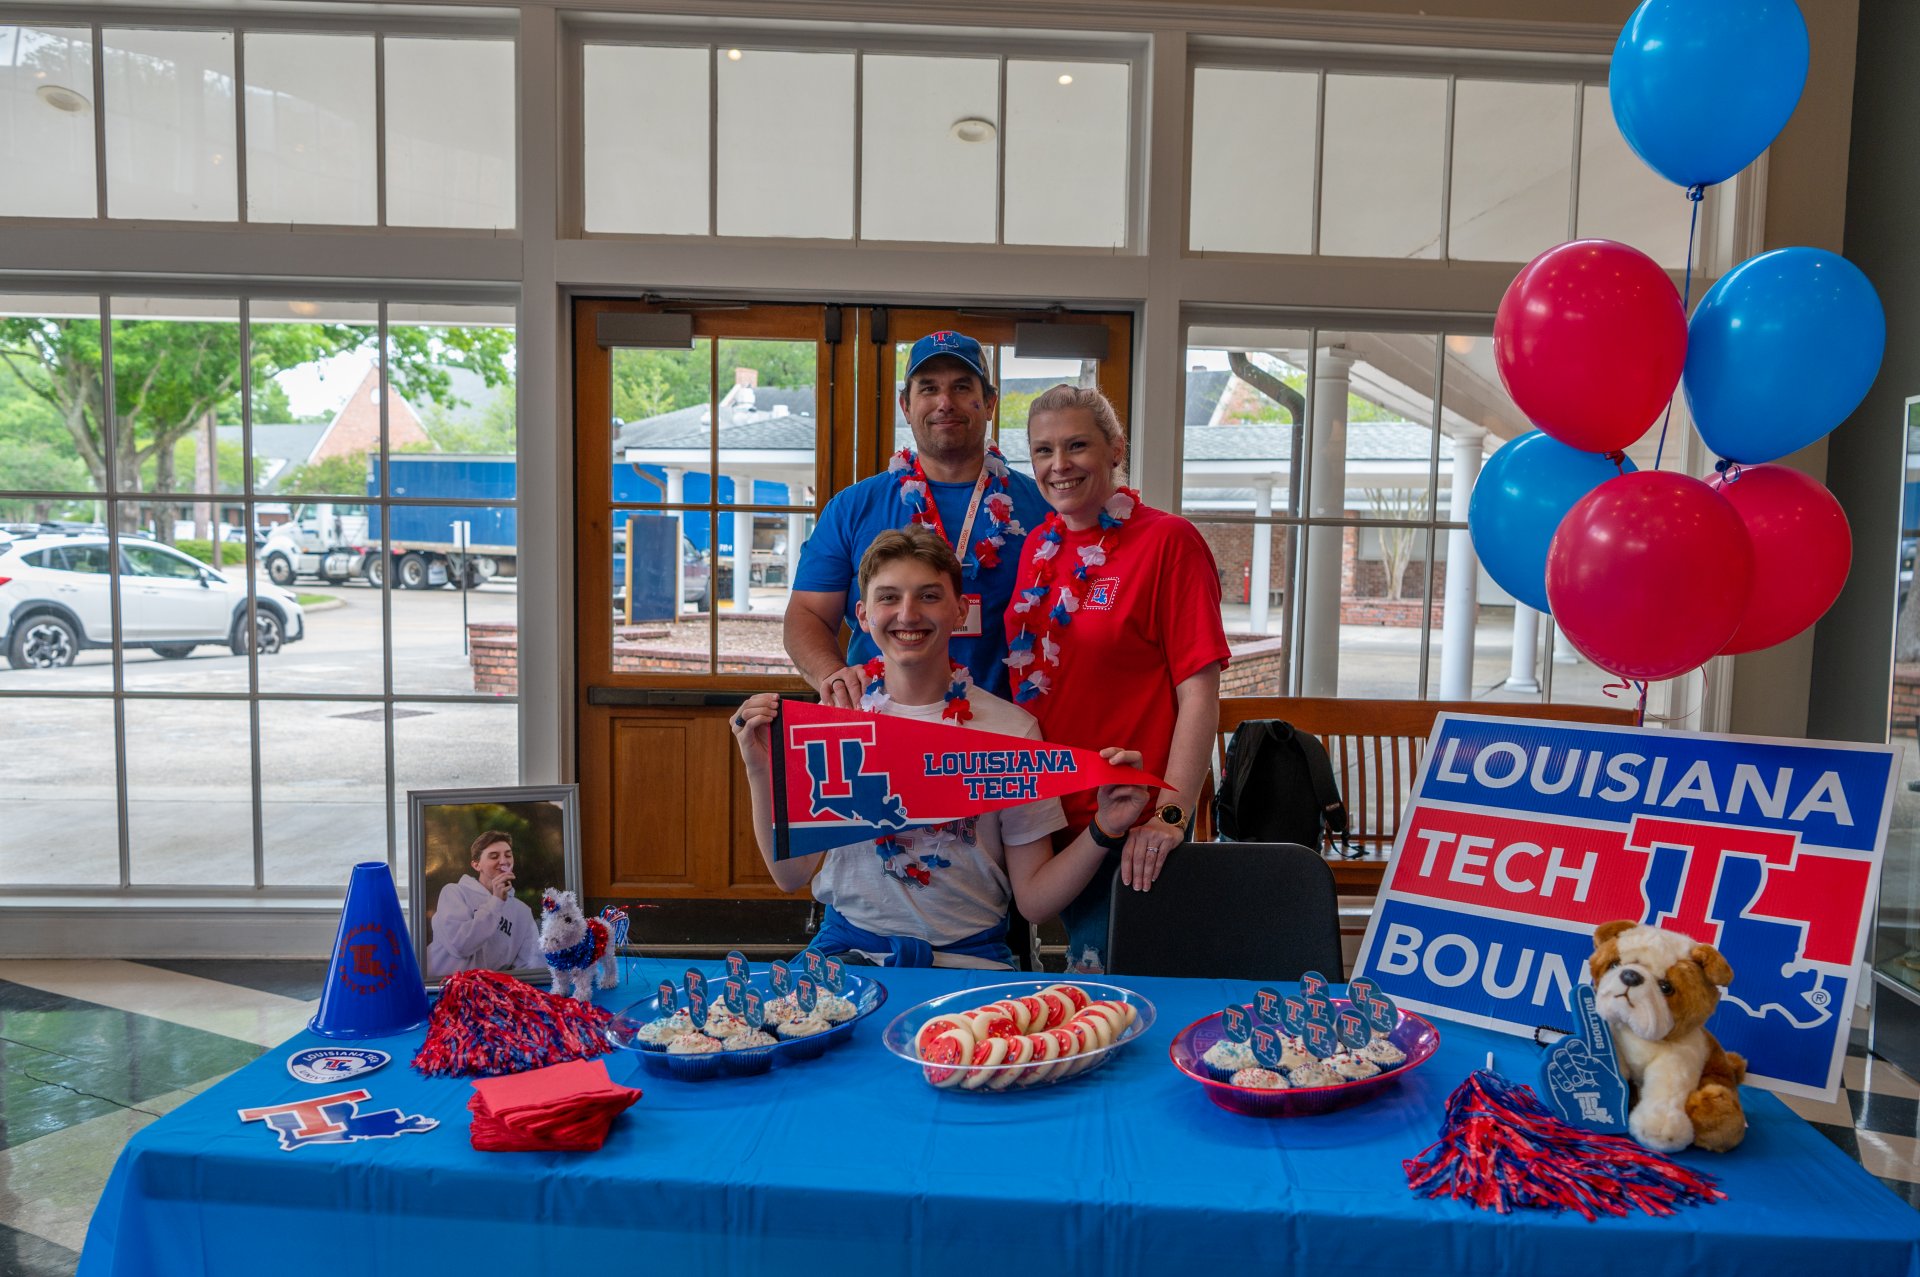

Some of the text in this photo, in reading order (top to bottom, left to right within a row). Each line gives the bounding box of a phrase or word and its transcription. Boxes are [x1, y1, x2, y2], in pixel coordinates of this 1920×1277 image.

[968, 500, 978, 519] VISITOR
[960, 529, 969, 550] VISITOR
[924, 750, 1077, 776] LOUISIANA
[963, 775, 1038, 800] TECH
[1436, 737, 1855, 827] LOUISIANA
[1416, 828, 1599, 903] TECH
[1376, 922, 1594, 1013] BOUN
[1584, 996, 1605, 1050] BULLDOGS
[303, 1051, 365, 1062] LOUISIANA
